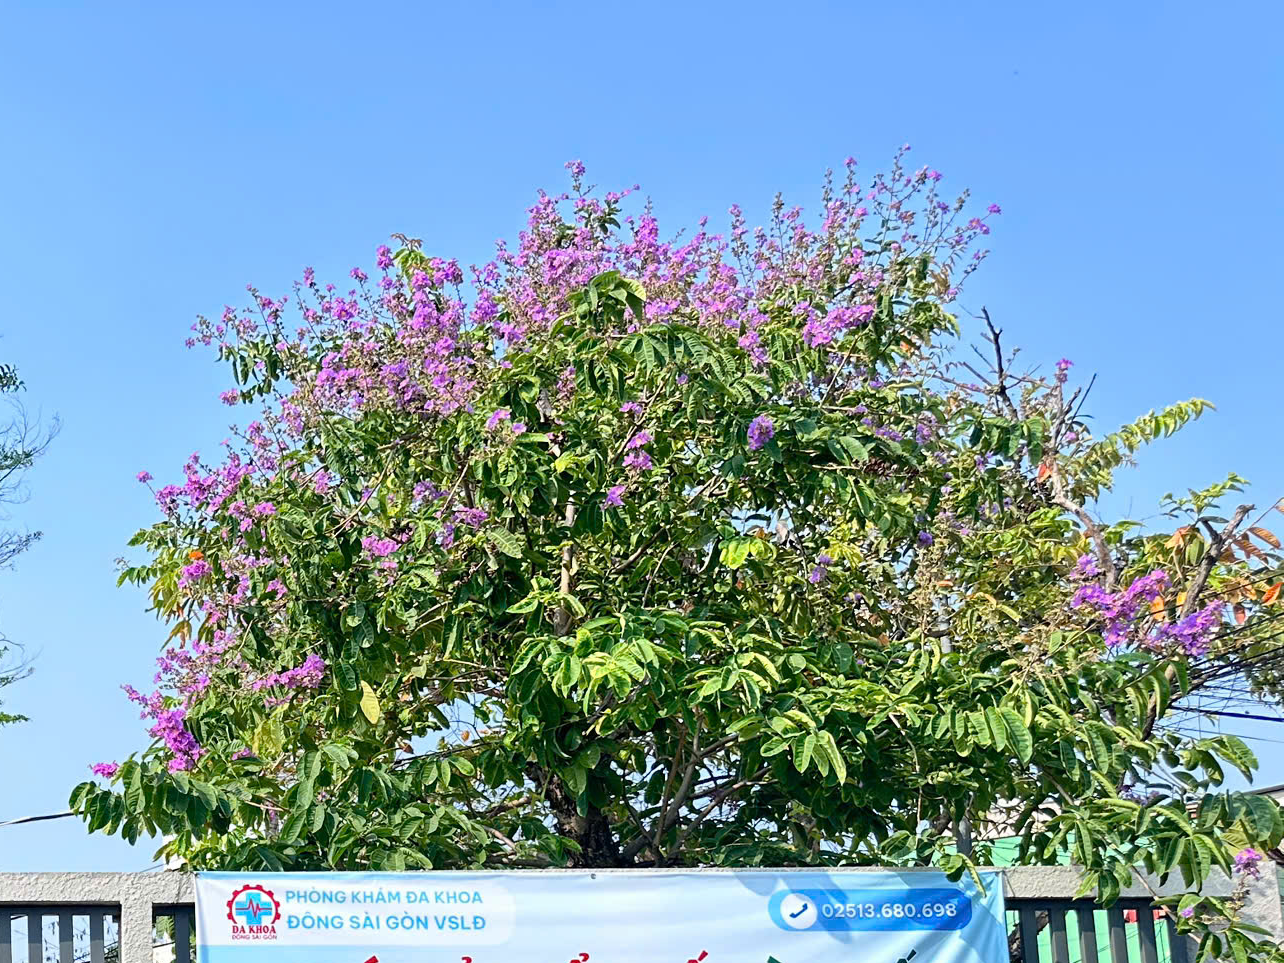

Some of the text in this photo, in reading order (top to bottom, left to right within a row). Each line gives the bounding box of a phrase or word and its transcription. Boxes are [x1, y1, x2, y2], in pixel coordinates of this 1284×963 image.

[285, 887, 483, 904] PHÒNG KHÁM ĐA KHOA
[821, 902, 958, 919] 02513.680.698
[287, 911, 486, 930] ĐÔNG SÀI GÒN VSLĐ
